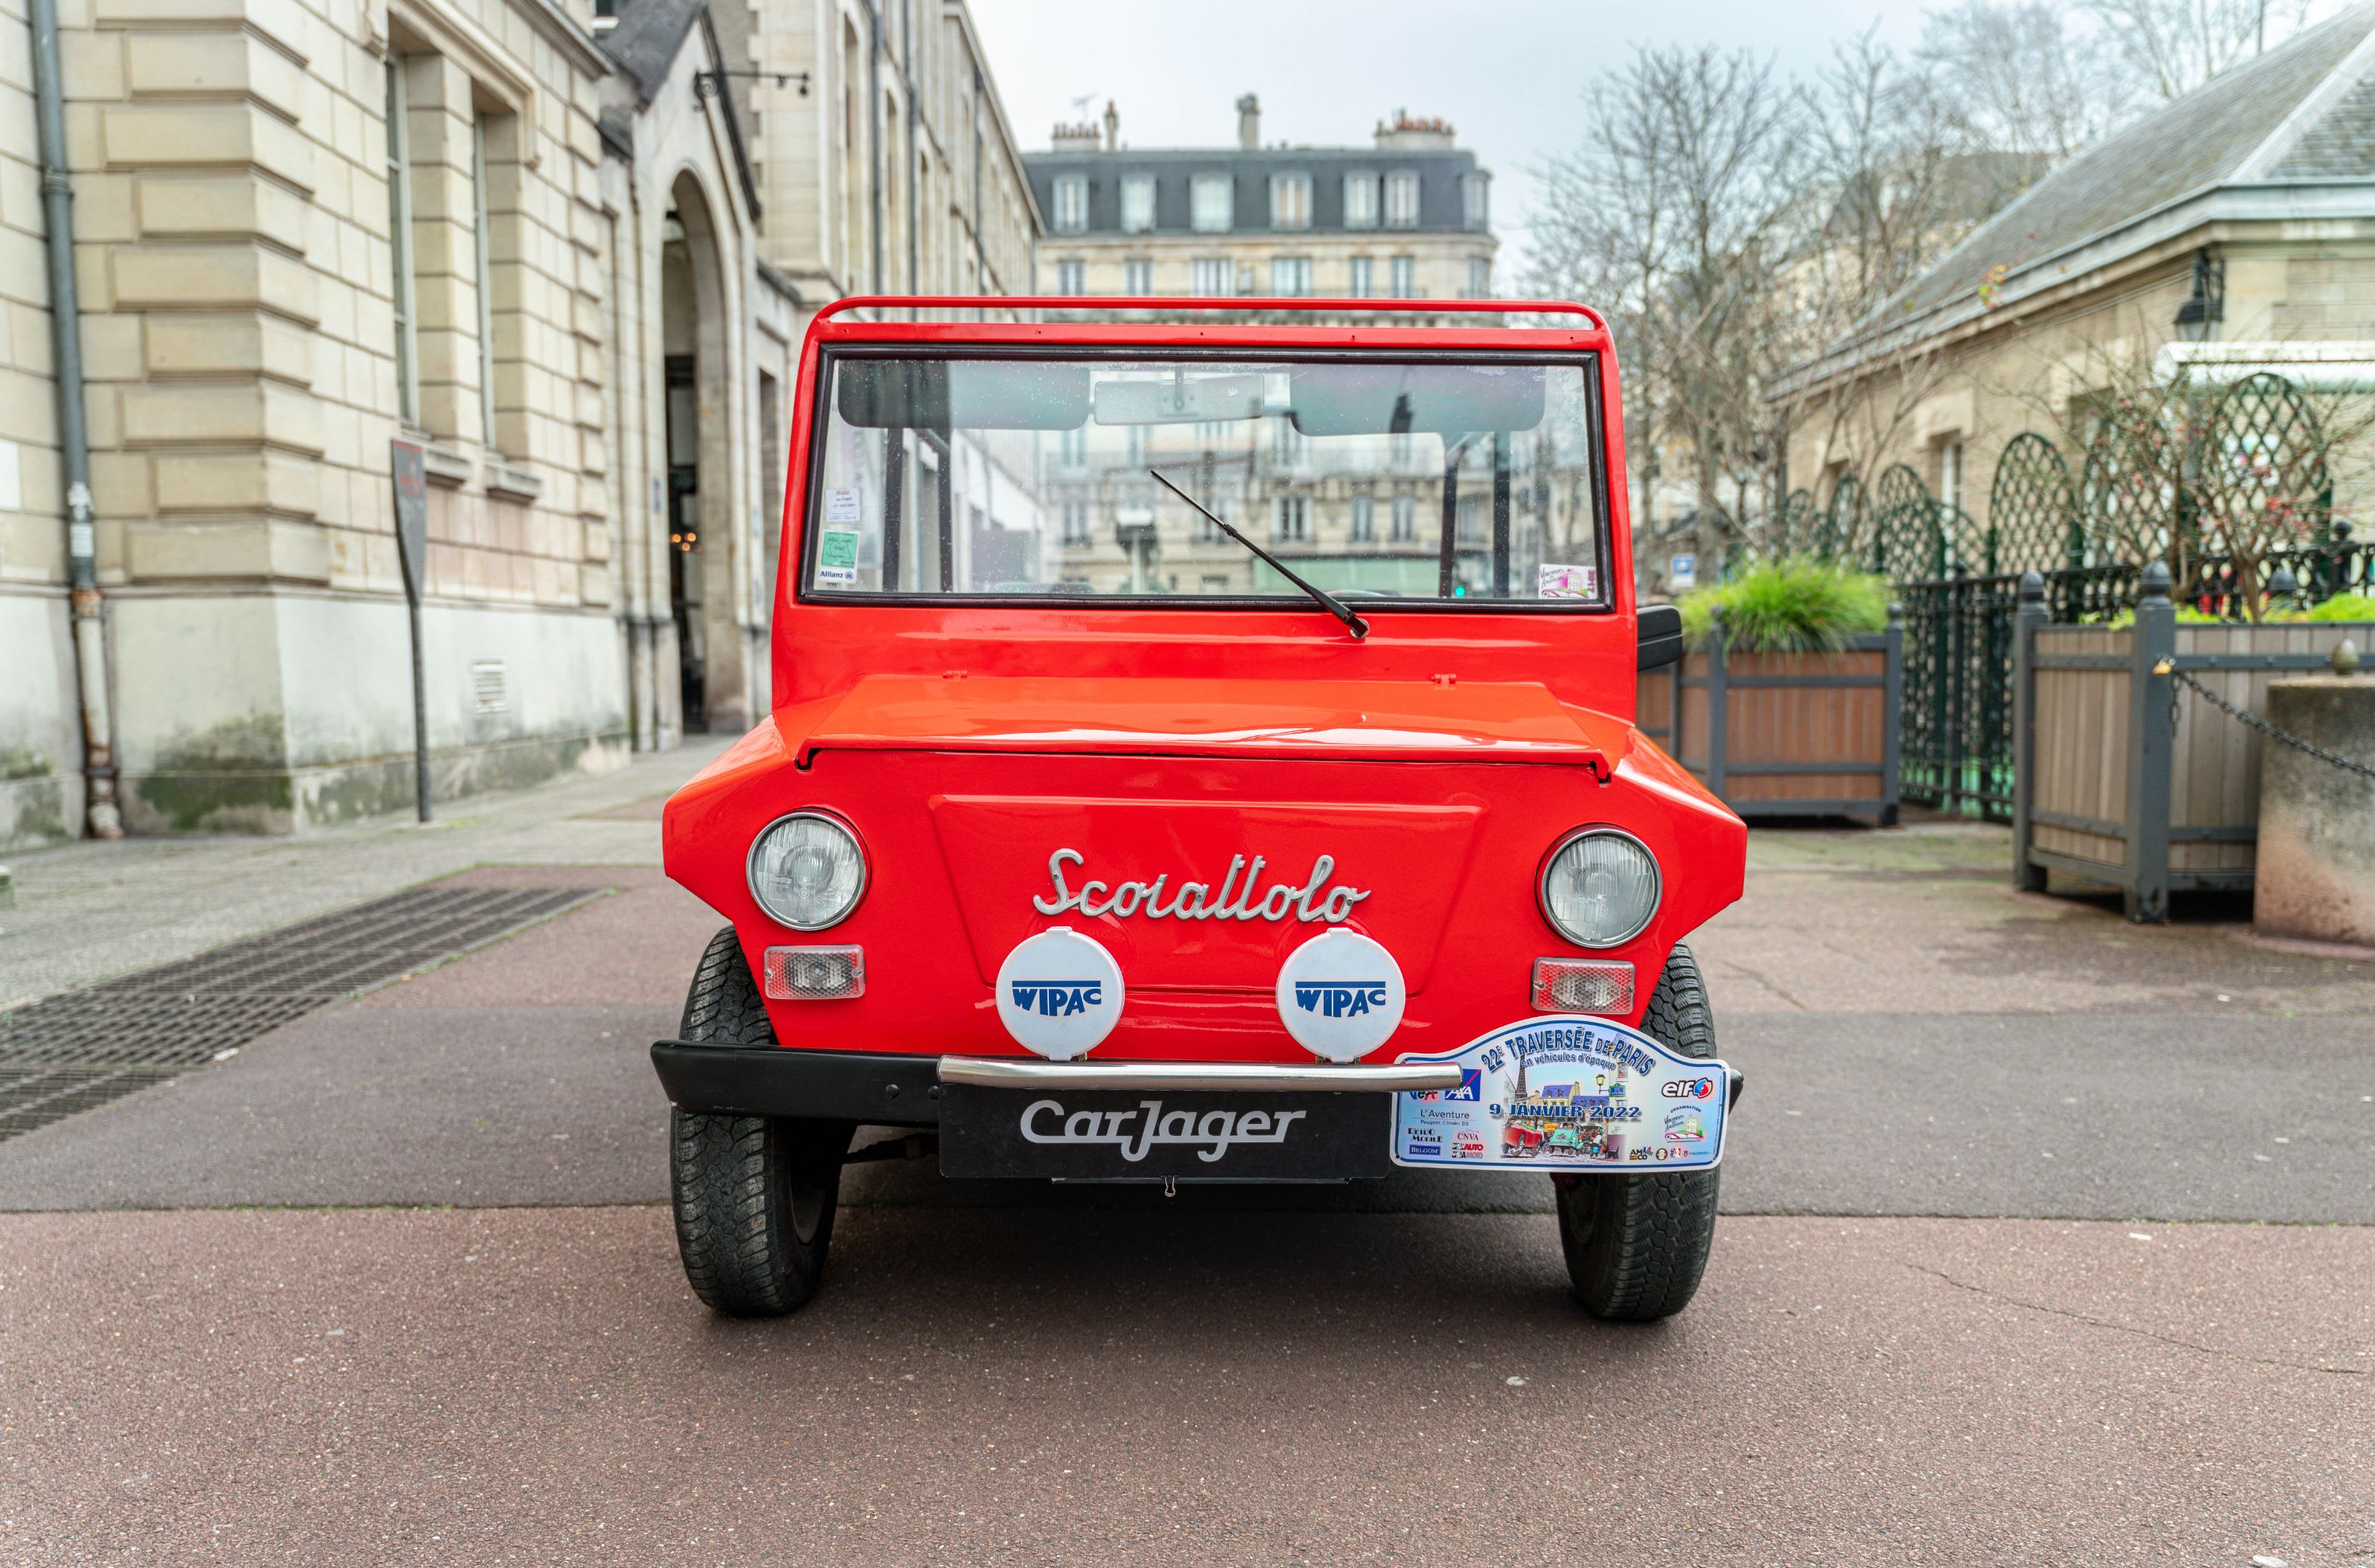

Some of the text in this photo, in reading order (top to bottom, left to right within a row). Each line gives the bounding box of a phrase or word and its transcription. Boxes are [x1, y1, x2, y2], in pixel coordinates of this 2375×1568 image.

[1033, 848, 1371, 924] Scoiattolo
[1012, 987, 1102, 1016] WIPAC
[1295, 987, 1386, 1017] WIPAC
[1505, 1027, 1594, 1058] TRAVERSÉE
[1612, 1038, 1655, 1076] PARIS
[1521, 1053, 1617, 1070] en véhicules d'époque
[1446, 1086, 1474, 1099] AXA
[1662, 1080, 1695, 1097] elf
[1489, 1103, 1641, 1118] 9 JANVIER 2022
[1020, 1099, 1307, 1163] CarJager
